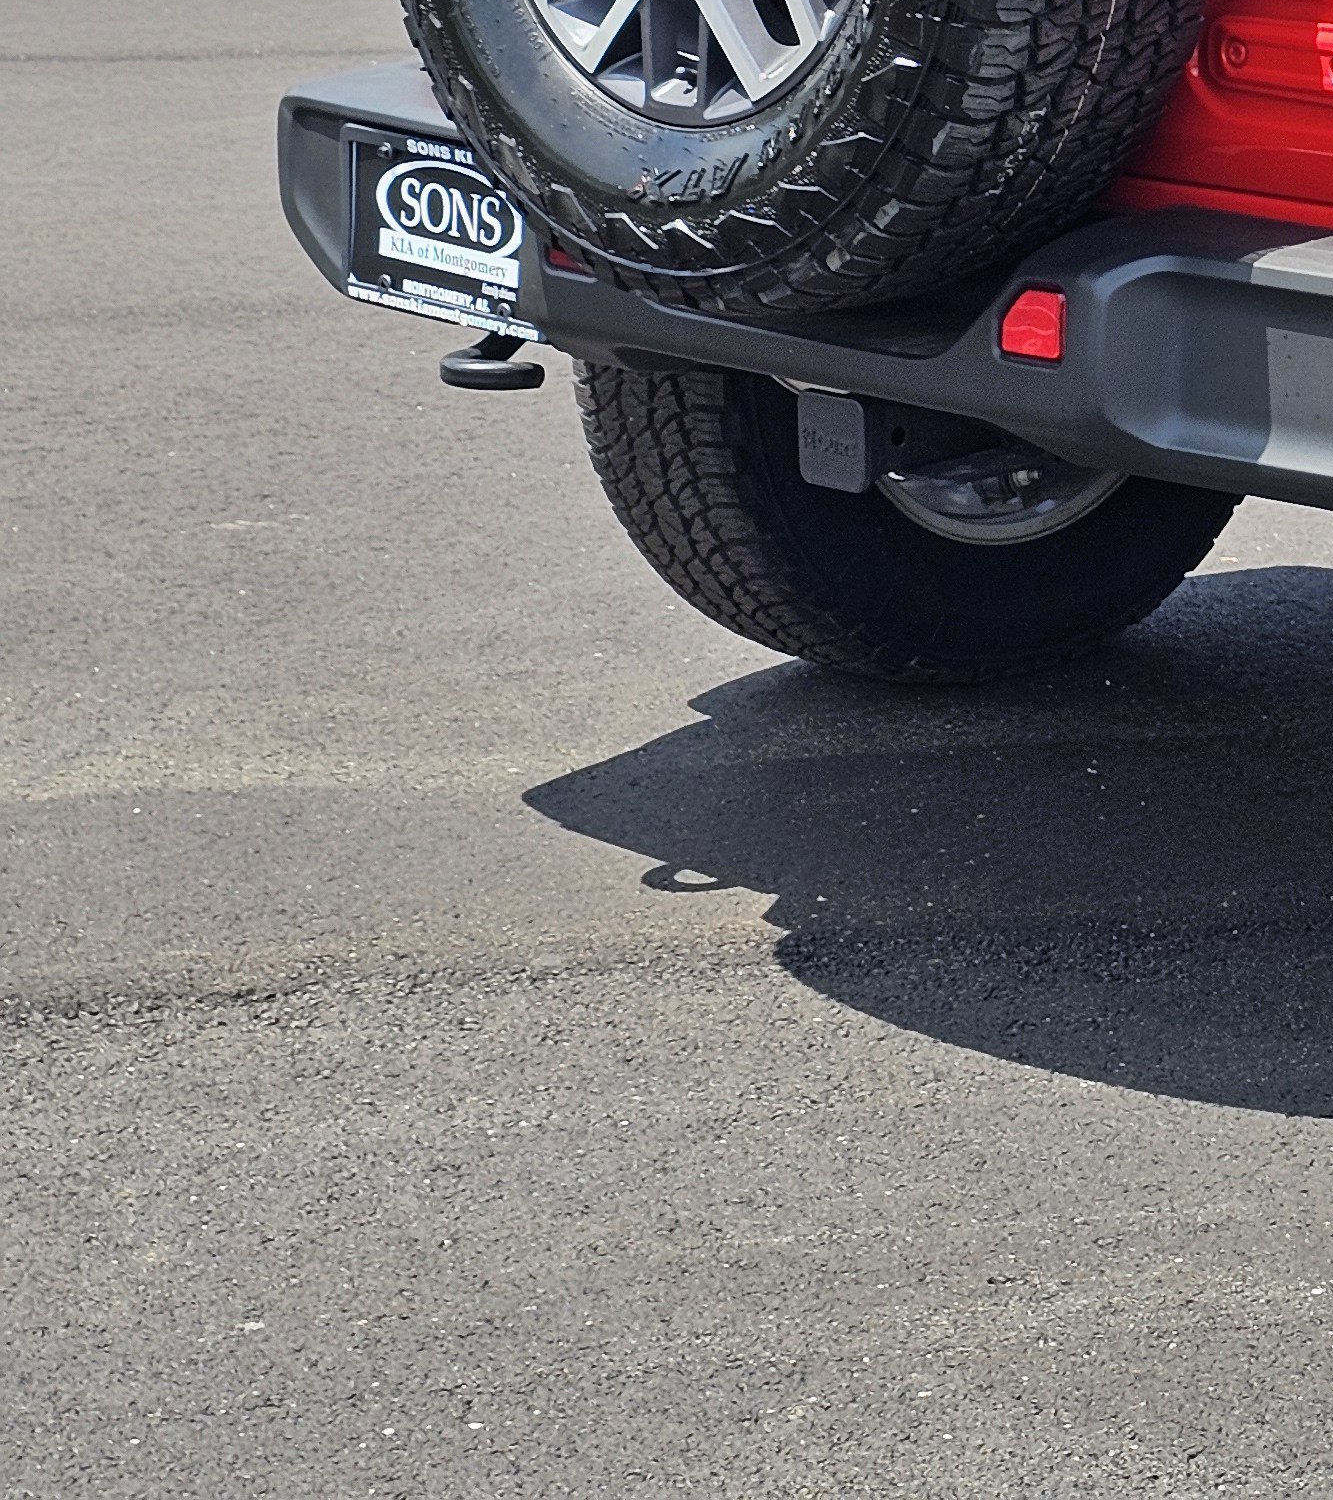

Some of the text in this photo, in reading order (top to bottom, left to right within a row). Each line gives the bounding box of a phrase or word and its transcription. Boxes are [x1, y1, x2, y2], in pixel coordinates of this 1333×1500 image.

[406, 138, 475, 165] SONS KI
[399, 176, 502, 247] SONS
[390, 235, 508, 282] KIA of Montgomery
